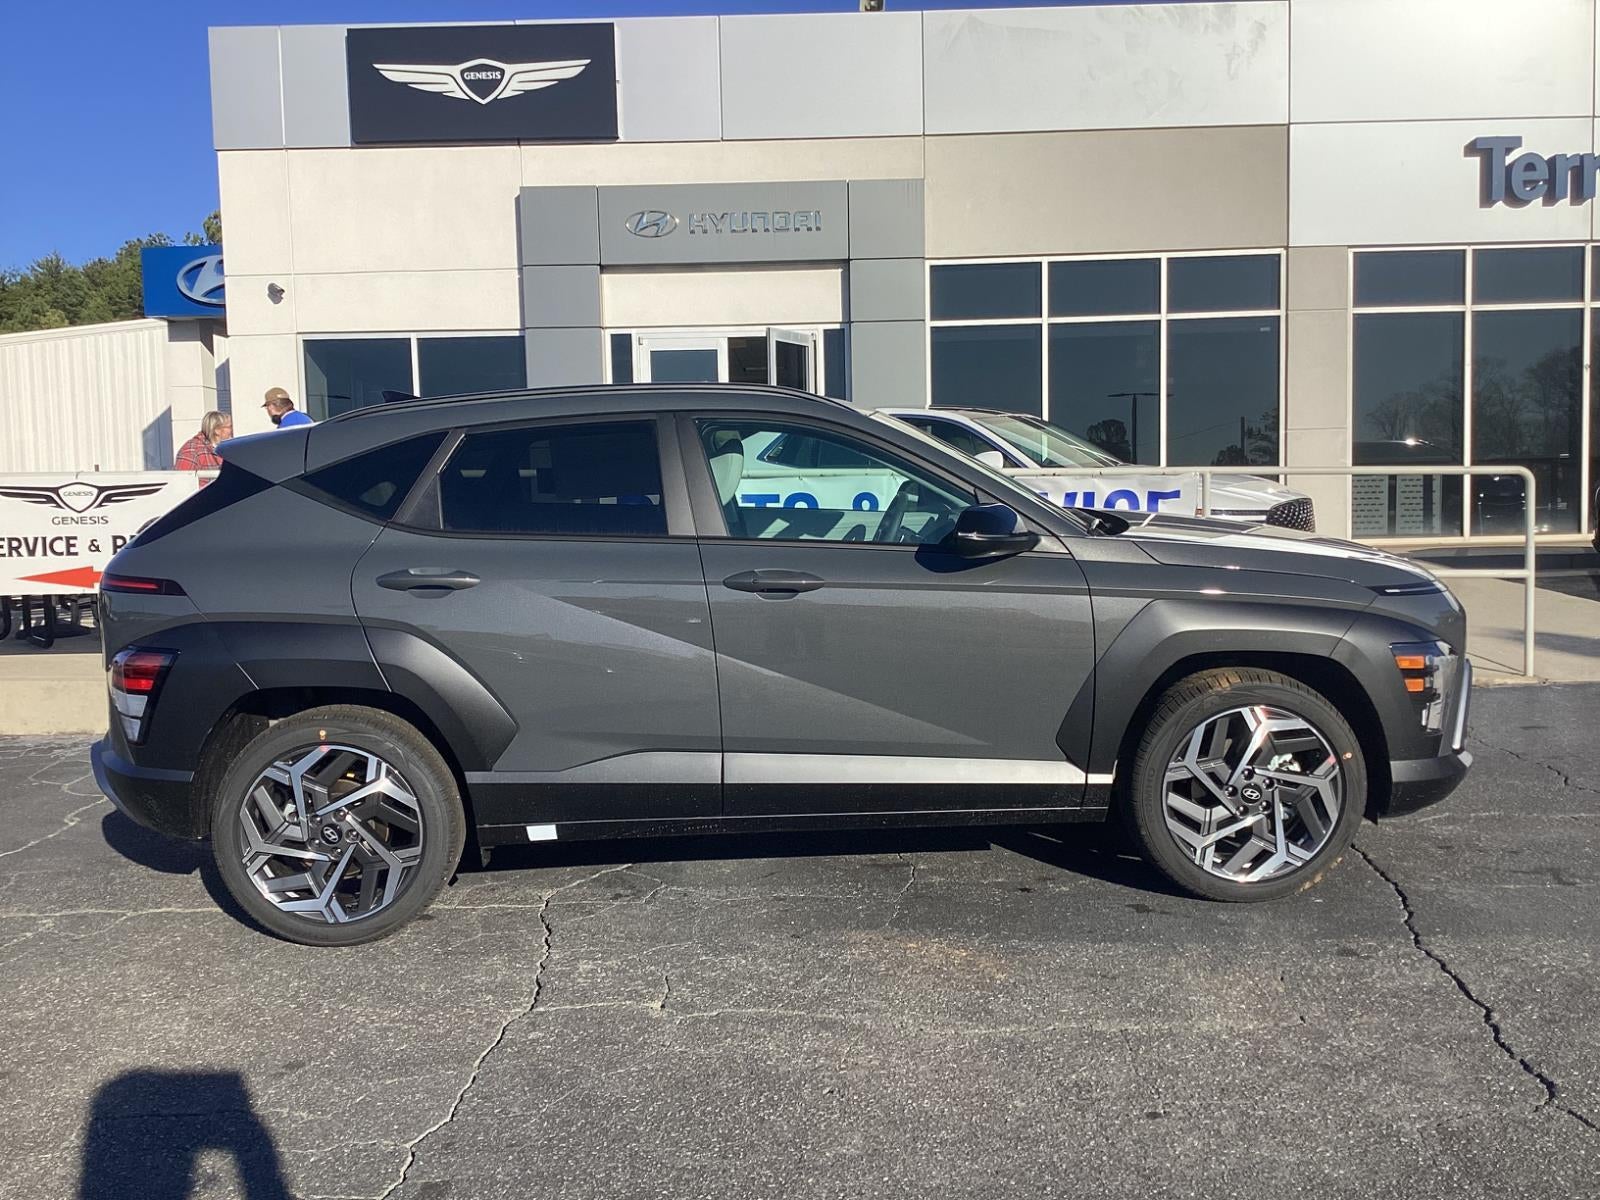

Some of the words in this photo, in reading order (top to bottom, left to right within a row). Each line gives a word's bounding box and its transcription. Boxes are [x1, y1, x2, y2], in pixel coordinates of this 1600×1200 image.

[463, 71, 502, 80] GENESIS
[688, 210, 822, 235] HYUNDAI
[51, 515, 110, 526] GENESIS
[87, 538, 102, 553] &
